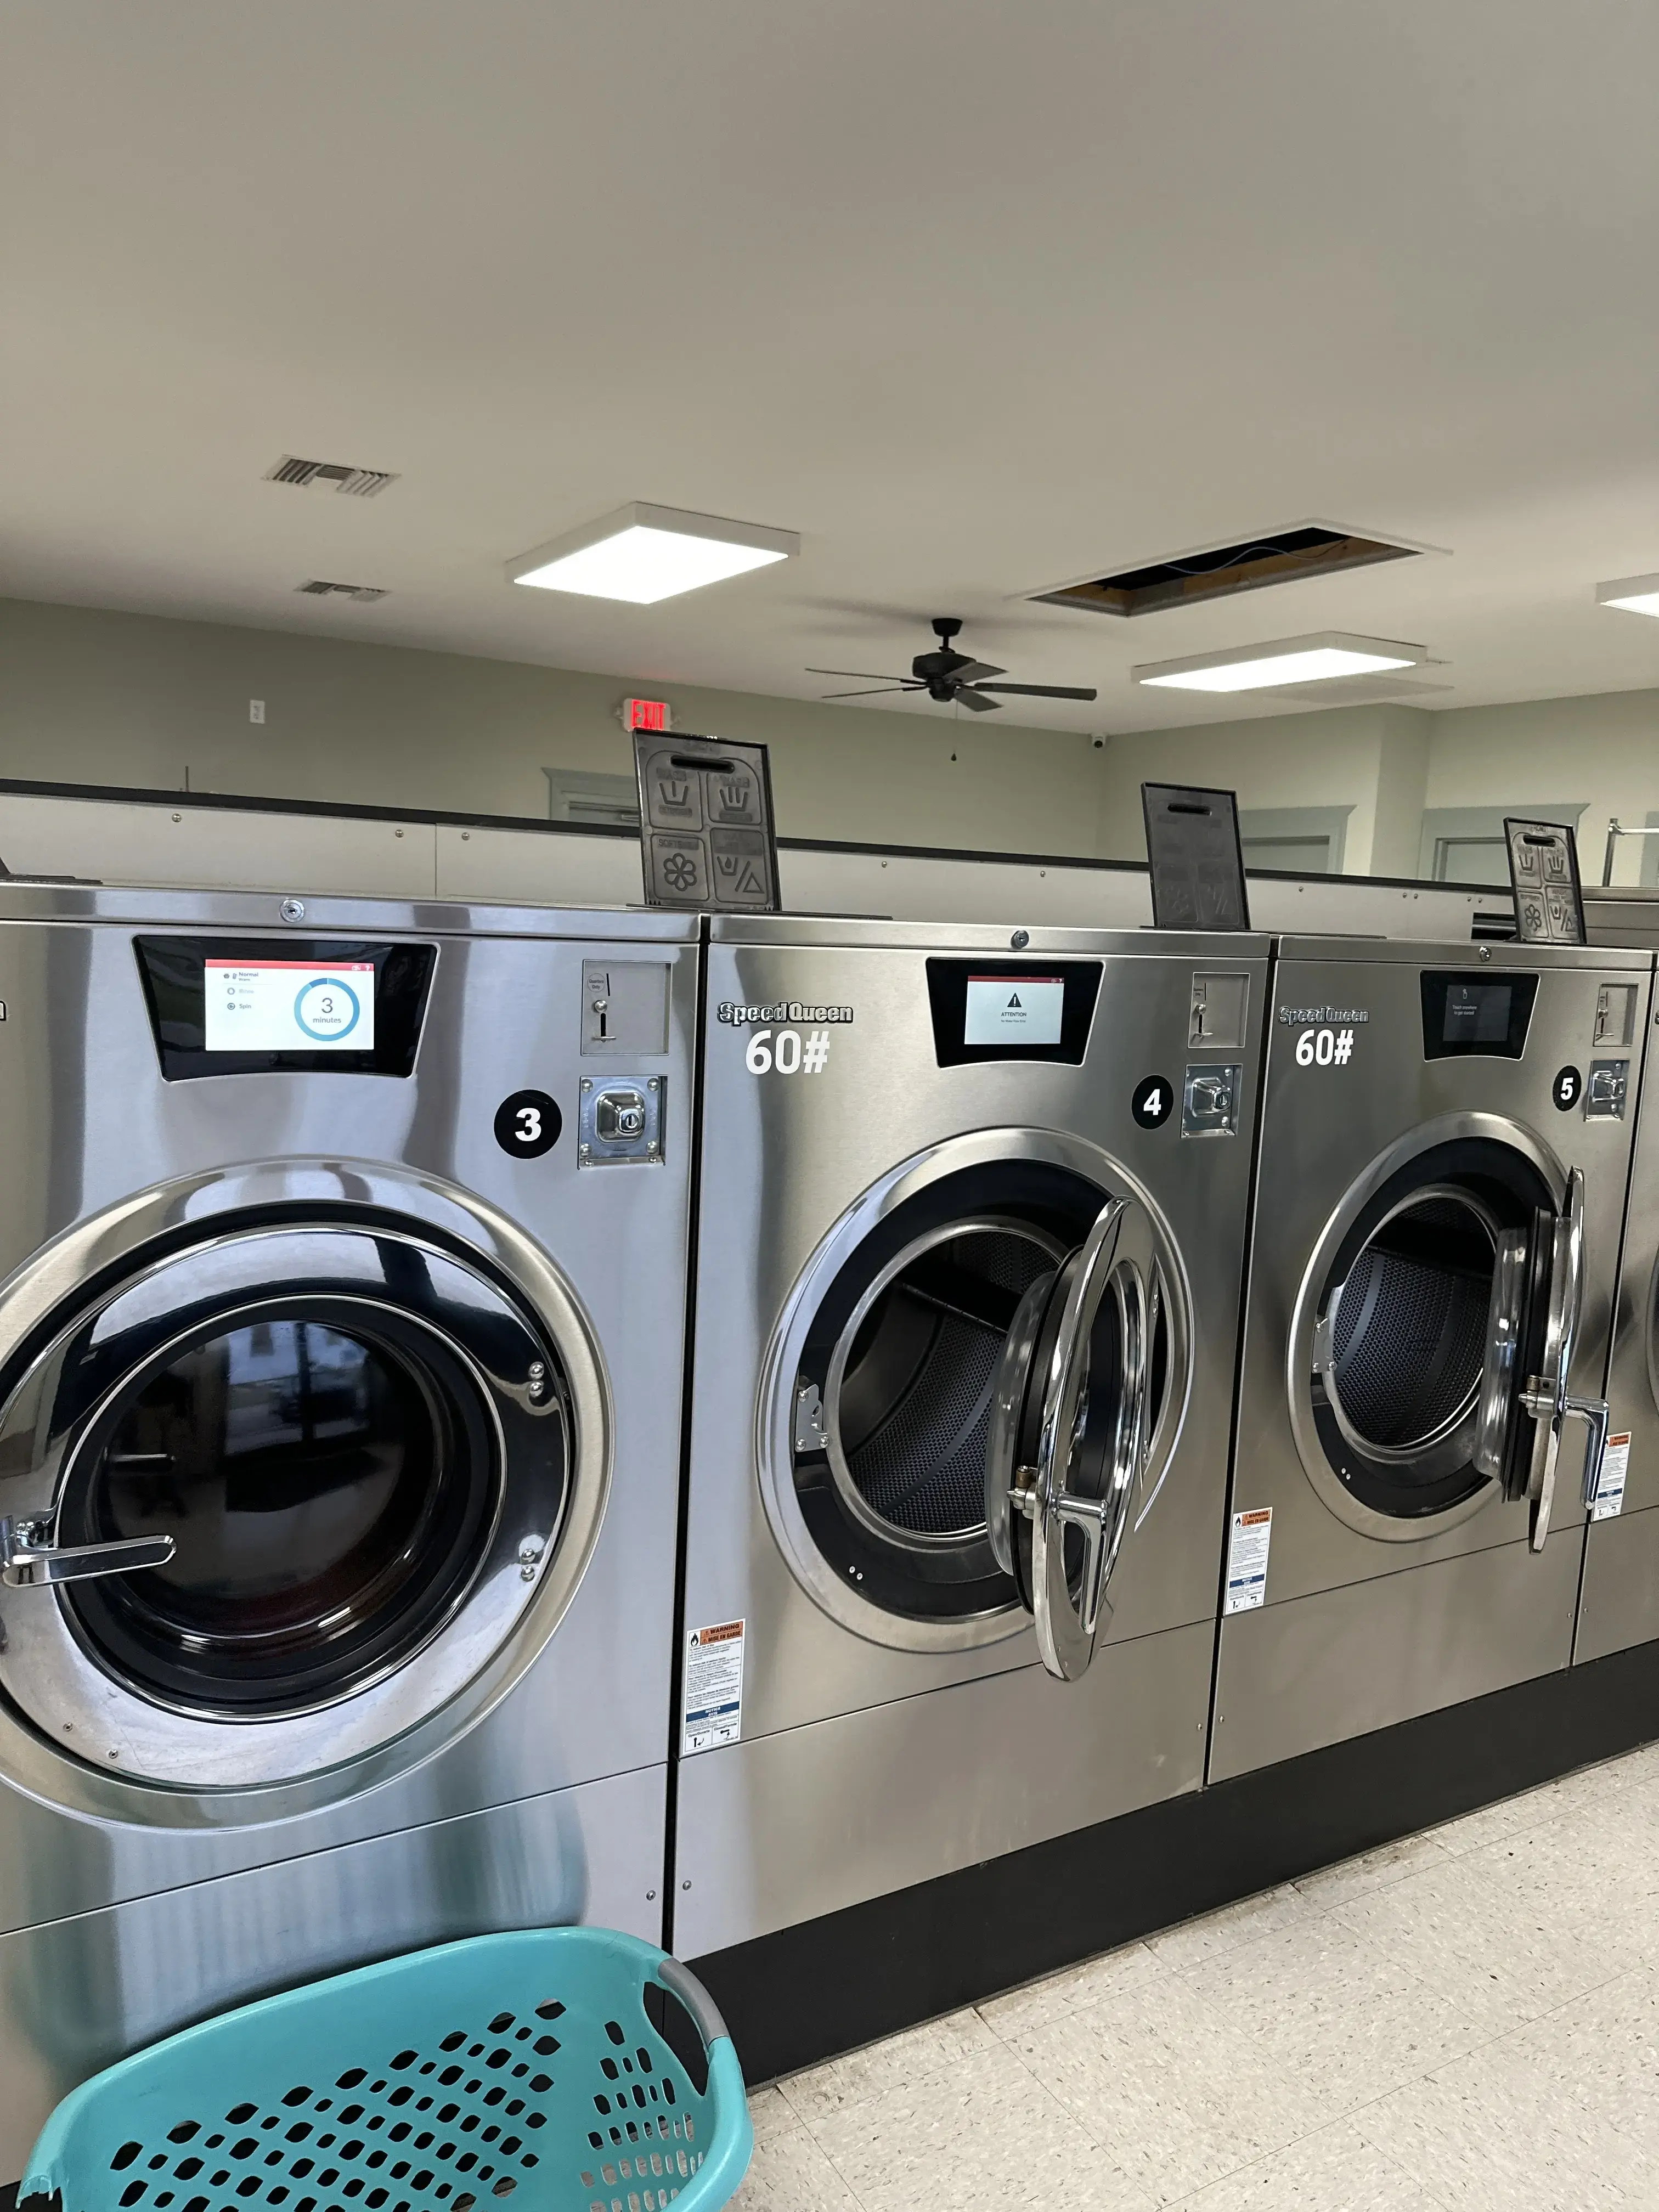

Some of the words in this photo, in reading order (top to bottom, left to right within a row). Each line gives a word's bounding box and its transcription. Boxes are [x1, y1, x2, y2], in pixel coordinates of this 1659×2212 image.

[631, 699, 666, 730] EXIT
[321, 997, 334, 1014] 3
[717, 1002, 788, 1026] Speed
[788, 1002, 853, 1023] Queen
[1279, 1006, 1326, 1026] Speed
[1326, 1006, 1369, 1023] Queen
[746, 1030, 830, 1074] 60#
[1296, 1029, 1354, 1065] 60#
[1560, 1077, 1573, 1100] 5
[1143, 1088, 1161, 1116] 4
[515, 1108, 541, 1142] 3
[710, 1623, 740, 1634] WARNING
